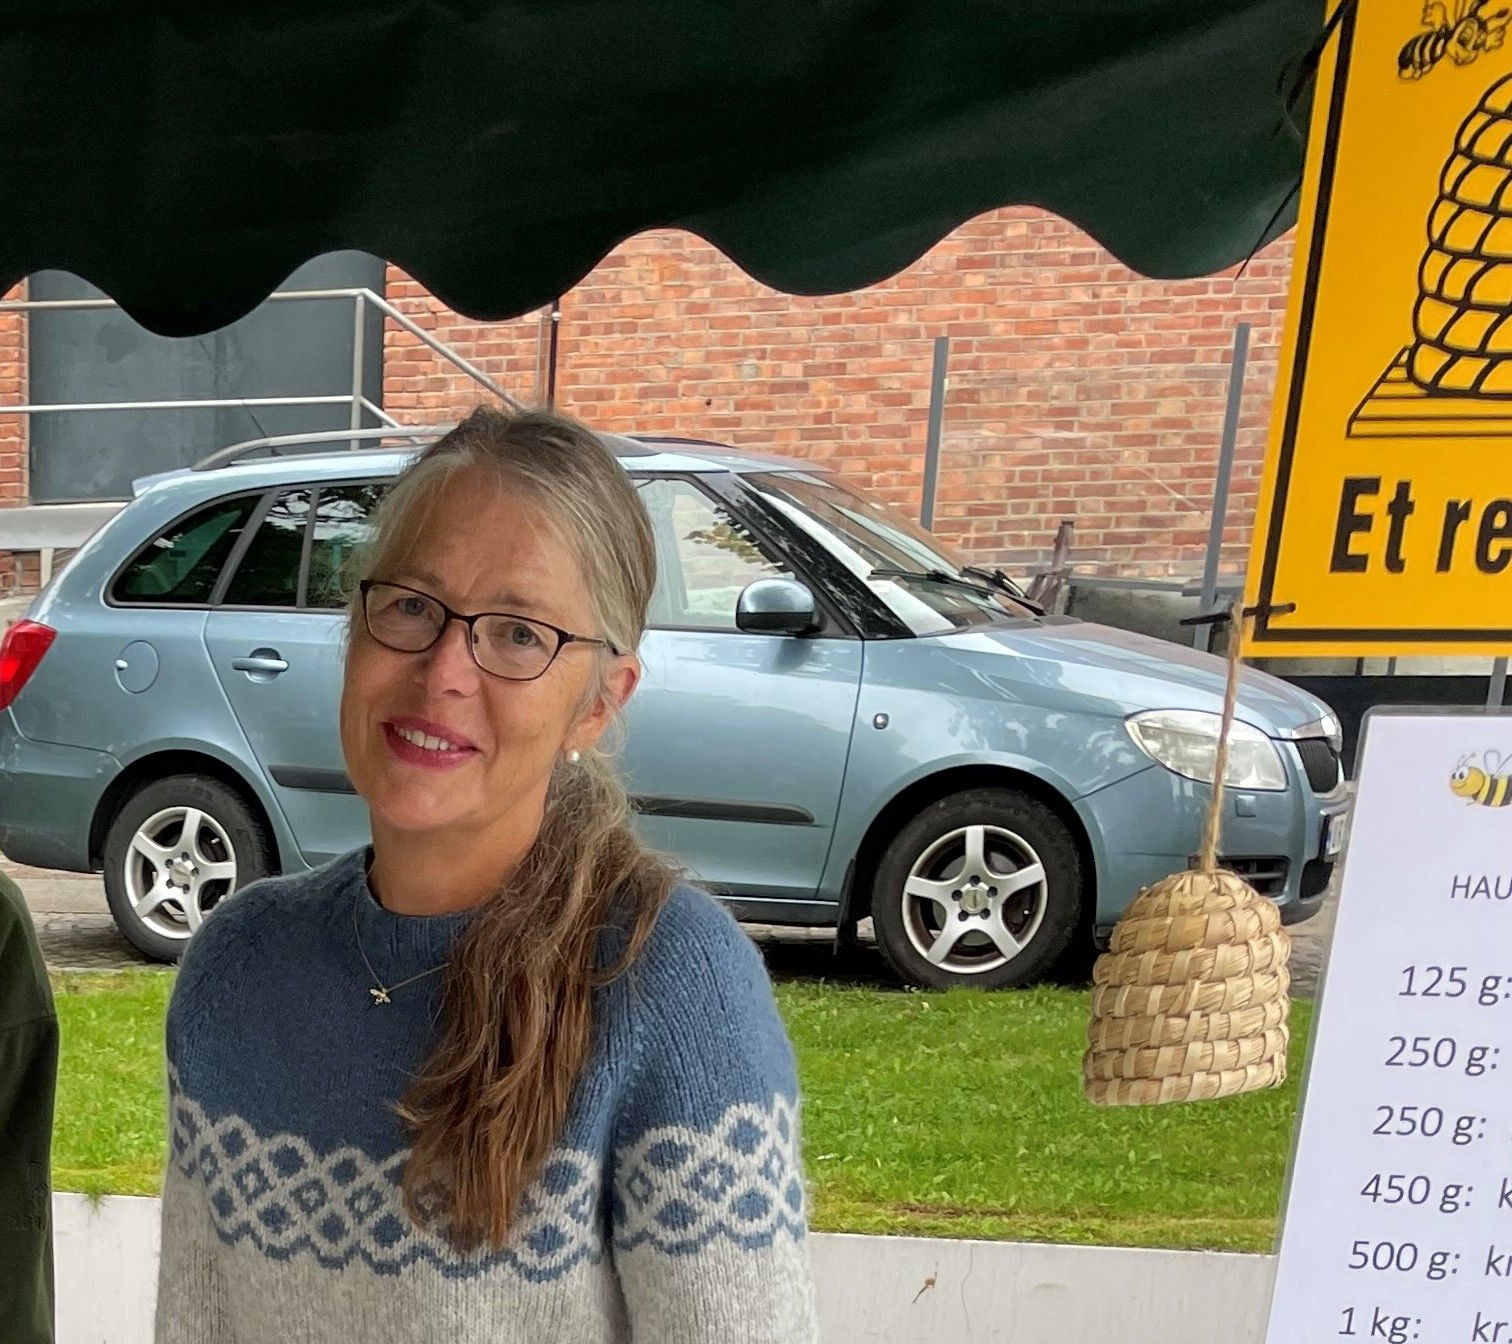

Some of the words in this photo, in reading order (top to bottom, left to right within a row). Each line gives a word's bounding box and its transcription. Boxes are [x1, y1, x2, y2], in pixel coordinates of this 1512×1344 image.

[1330, 476, 1414, 574] Et
[1398, 964, 1468, 999] 125
[1478, 973, 1512, 1008] g:
[1386, 1035, 1456, 1069] 250
[1465, 1043, 1500, 1078] g:
[1372, 1104, 1444, 1138] 250
[1452, 1112, 1487, 1148] g:
[1360, 1172, 1430, 1206] 450
[1439, 1179, 1474, 1215] g:
[1348, 1240, 1418, 1273] 500
[1427, 1249, 1461, 1281] g:
[1338, 1305, 1355, 1337] 1
[1370, 1305, 1423, 1344] kg:
